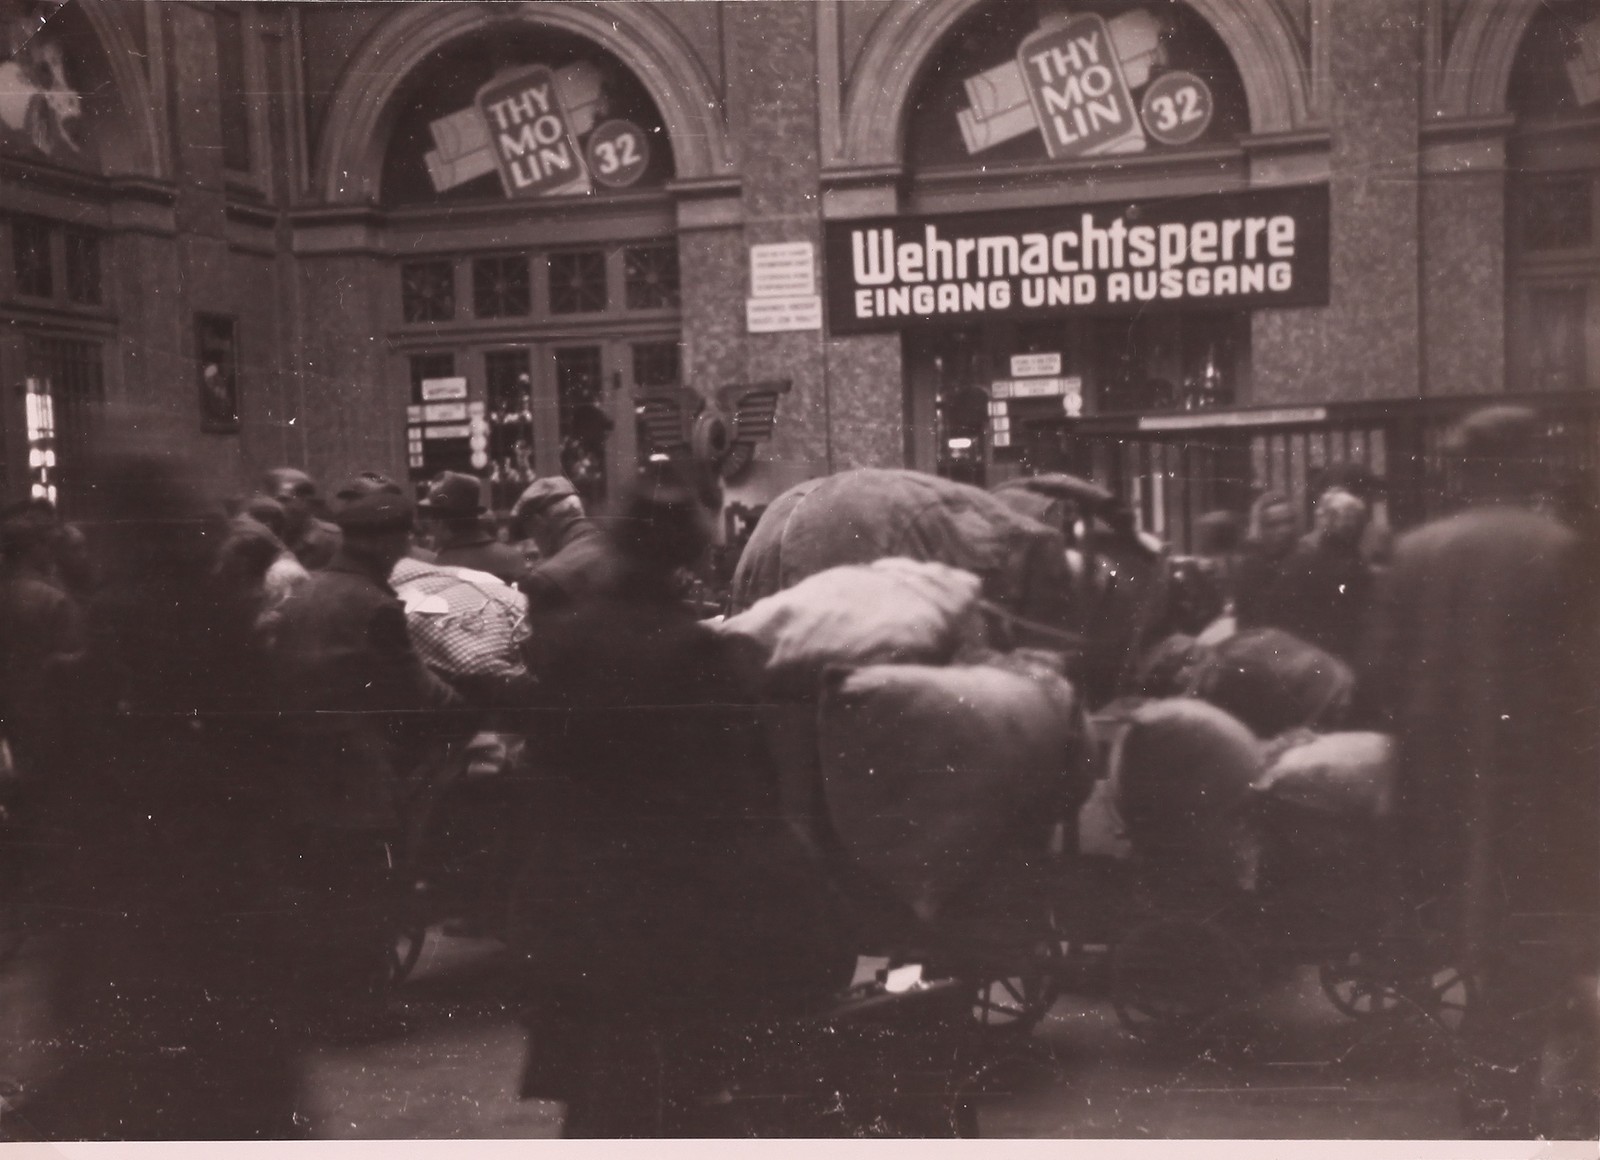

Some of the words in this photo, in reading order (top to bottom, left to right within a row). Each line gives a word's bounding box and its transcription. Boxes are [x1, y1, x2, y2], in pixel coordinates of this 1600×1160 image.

[1029, 31, 1100, 83] THY
[487, 83, 550, 129] THY
[1041, 65, 1112, 115] MO
[1151, 86, 1202, 131] 32
[500, 115, 562, 160] MO
[1053, 94, 1122, 145] LIN
[511, 142, 571, 188] LIN
[595, 133, 642, 174] 32
[851, 213, 1296, 286] Wehrmachtsperre
[854, 279, 1011, 319] EINGANG
[1021, 273, 1097, 307] UND
[1107, 261, 1293, 303] AUSGANG
